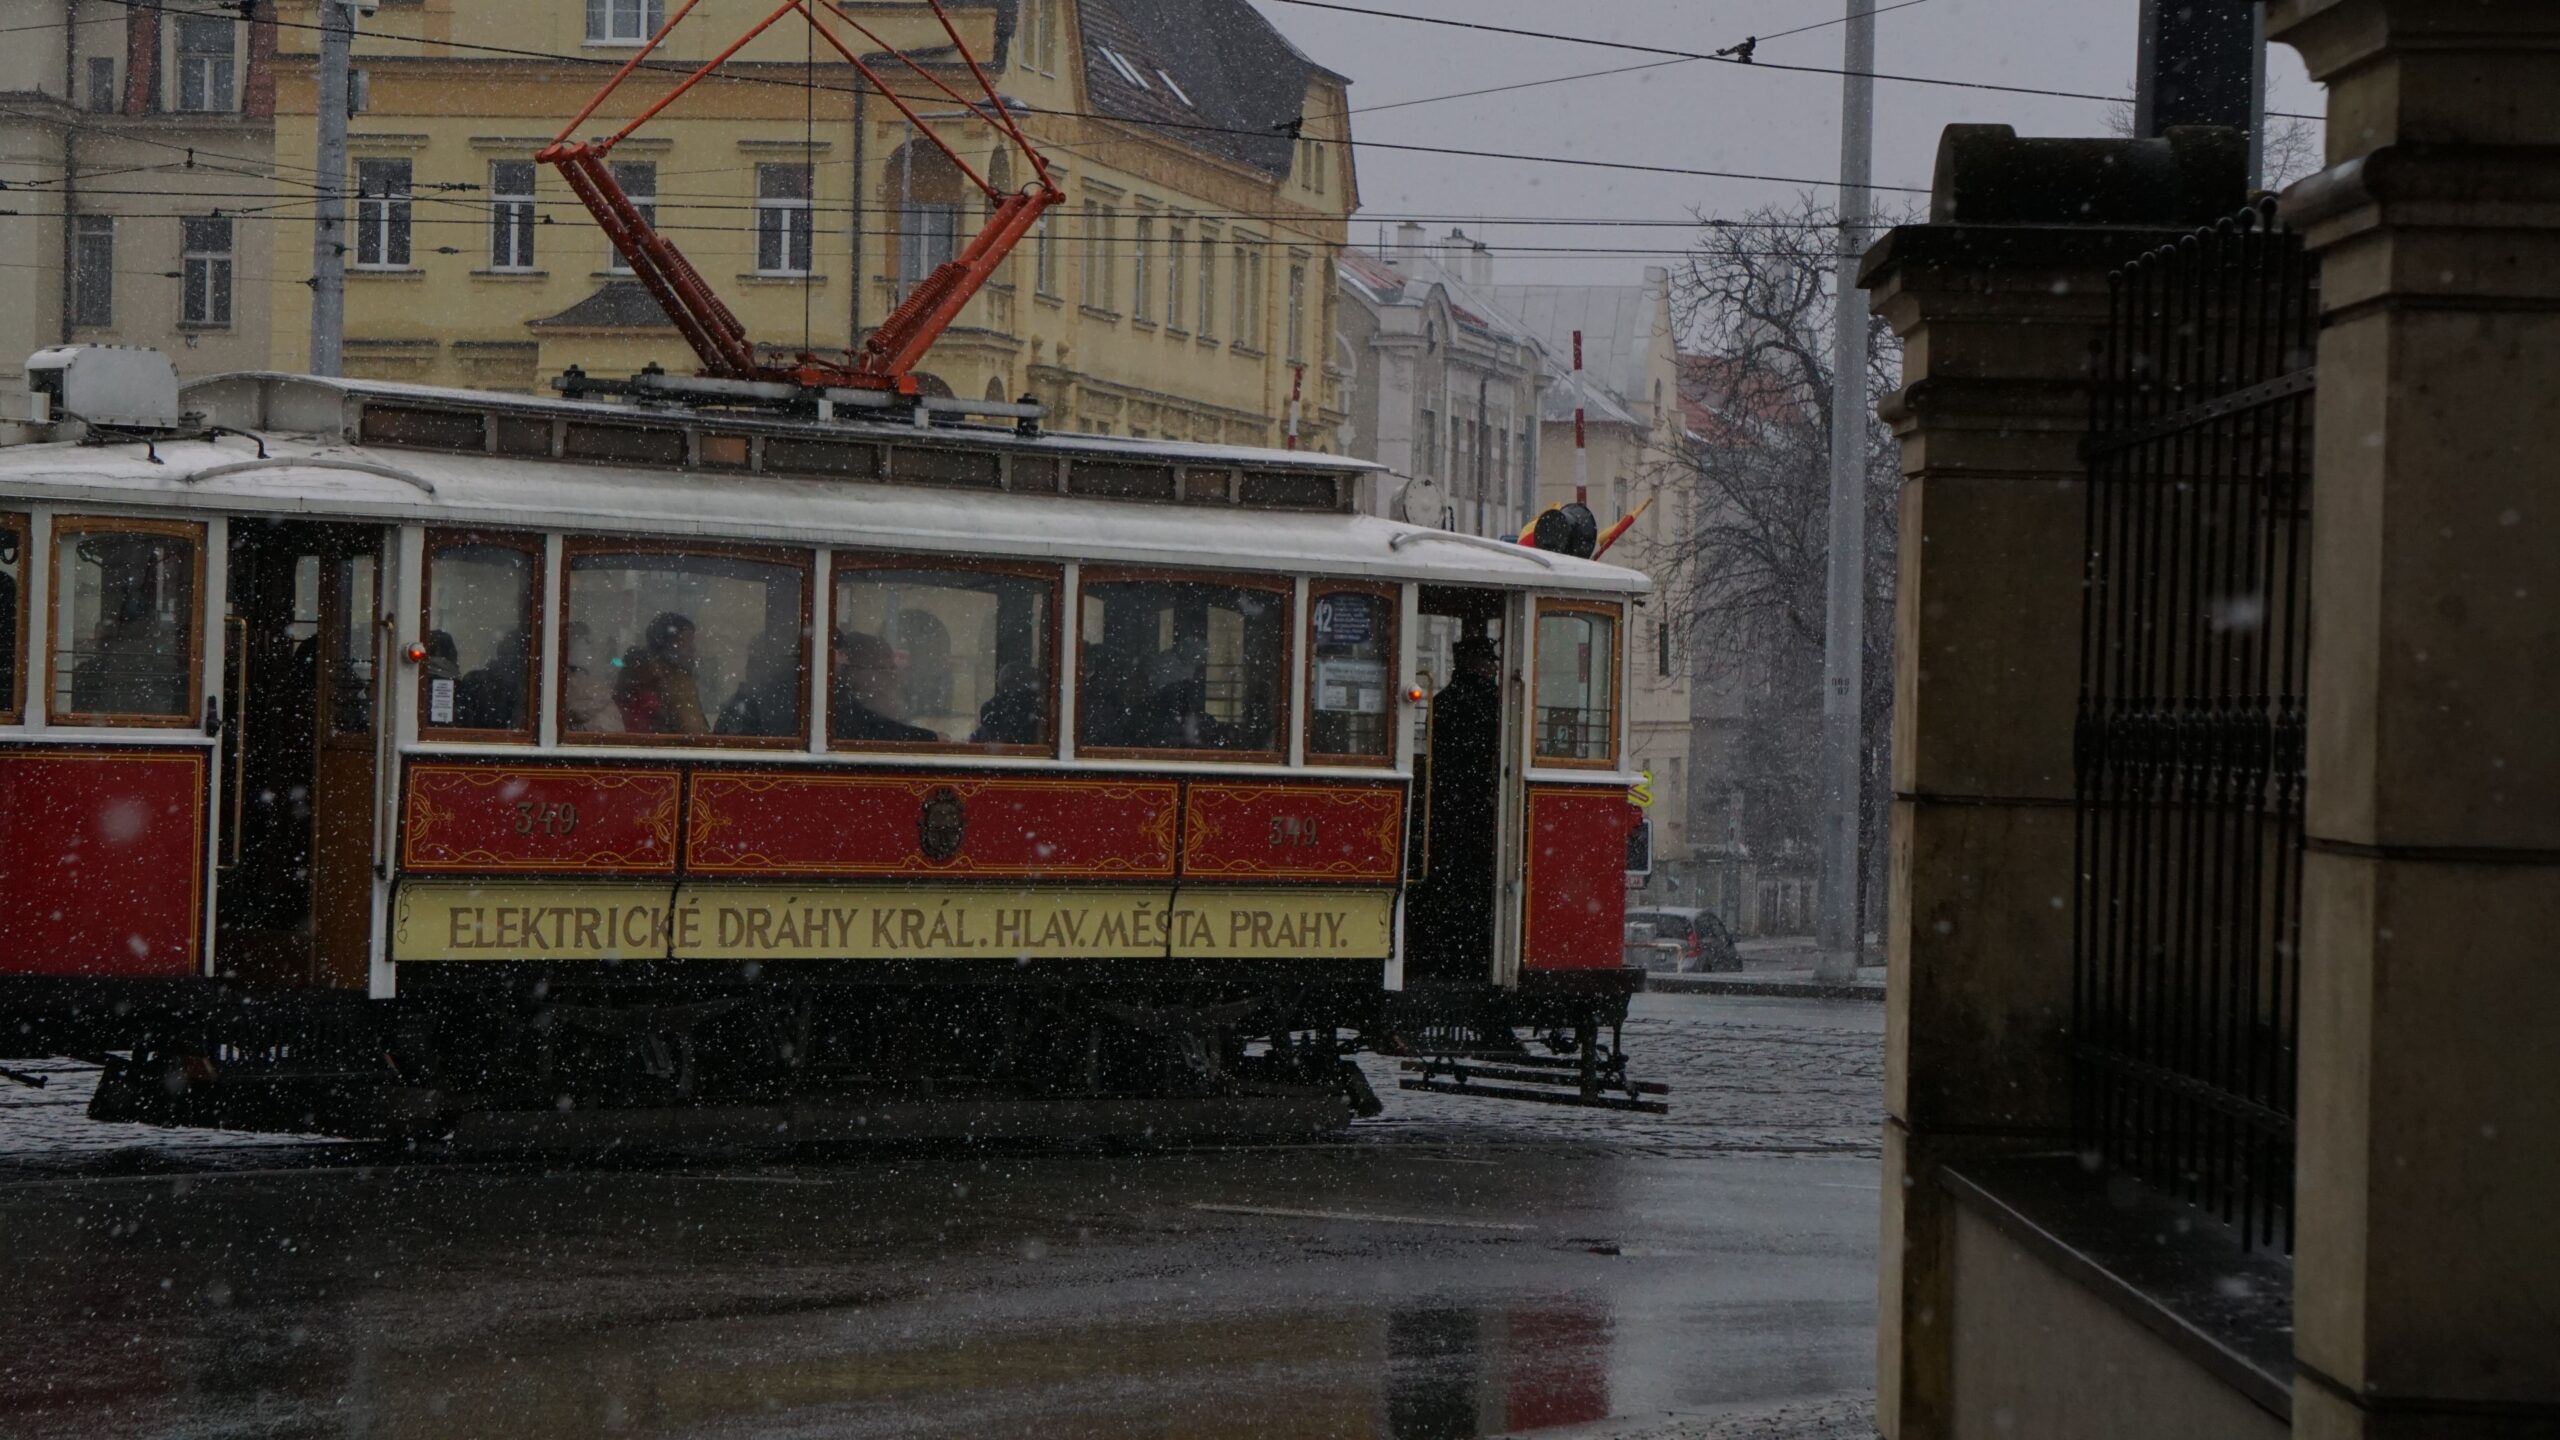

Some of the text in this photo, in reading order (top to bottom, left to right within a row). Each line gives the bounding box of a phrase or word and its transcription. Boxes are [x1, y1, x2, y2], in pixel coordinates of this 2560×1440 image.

[1314, 600, 1332, 632] 42
[515, 801, 577, 836] 349
[1269, 816, 1317, 847] 349
[449, 898, 703, 949] ELEKTRICKÉ
[718, 895, 858, 949] DRÁHY
[1092, 901, 1216, 948] MĚSTA
[1229, 909, 1347, 948] PRAHY.
